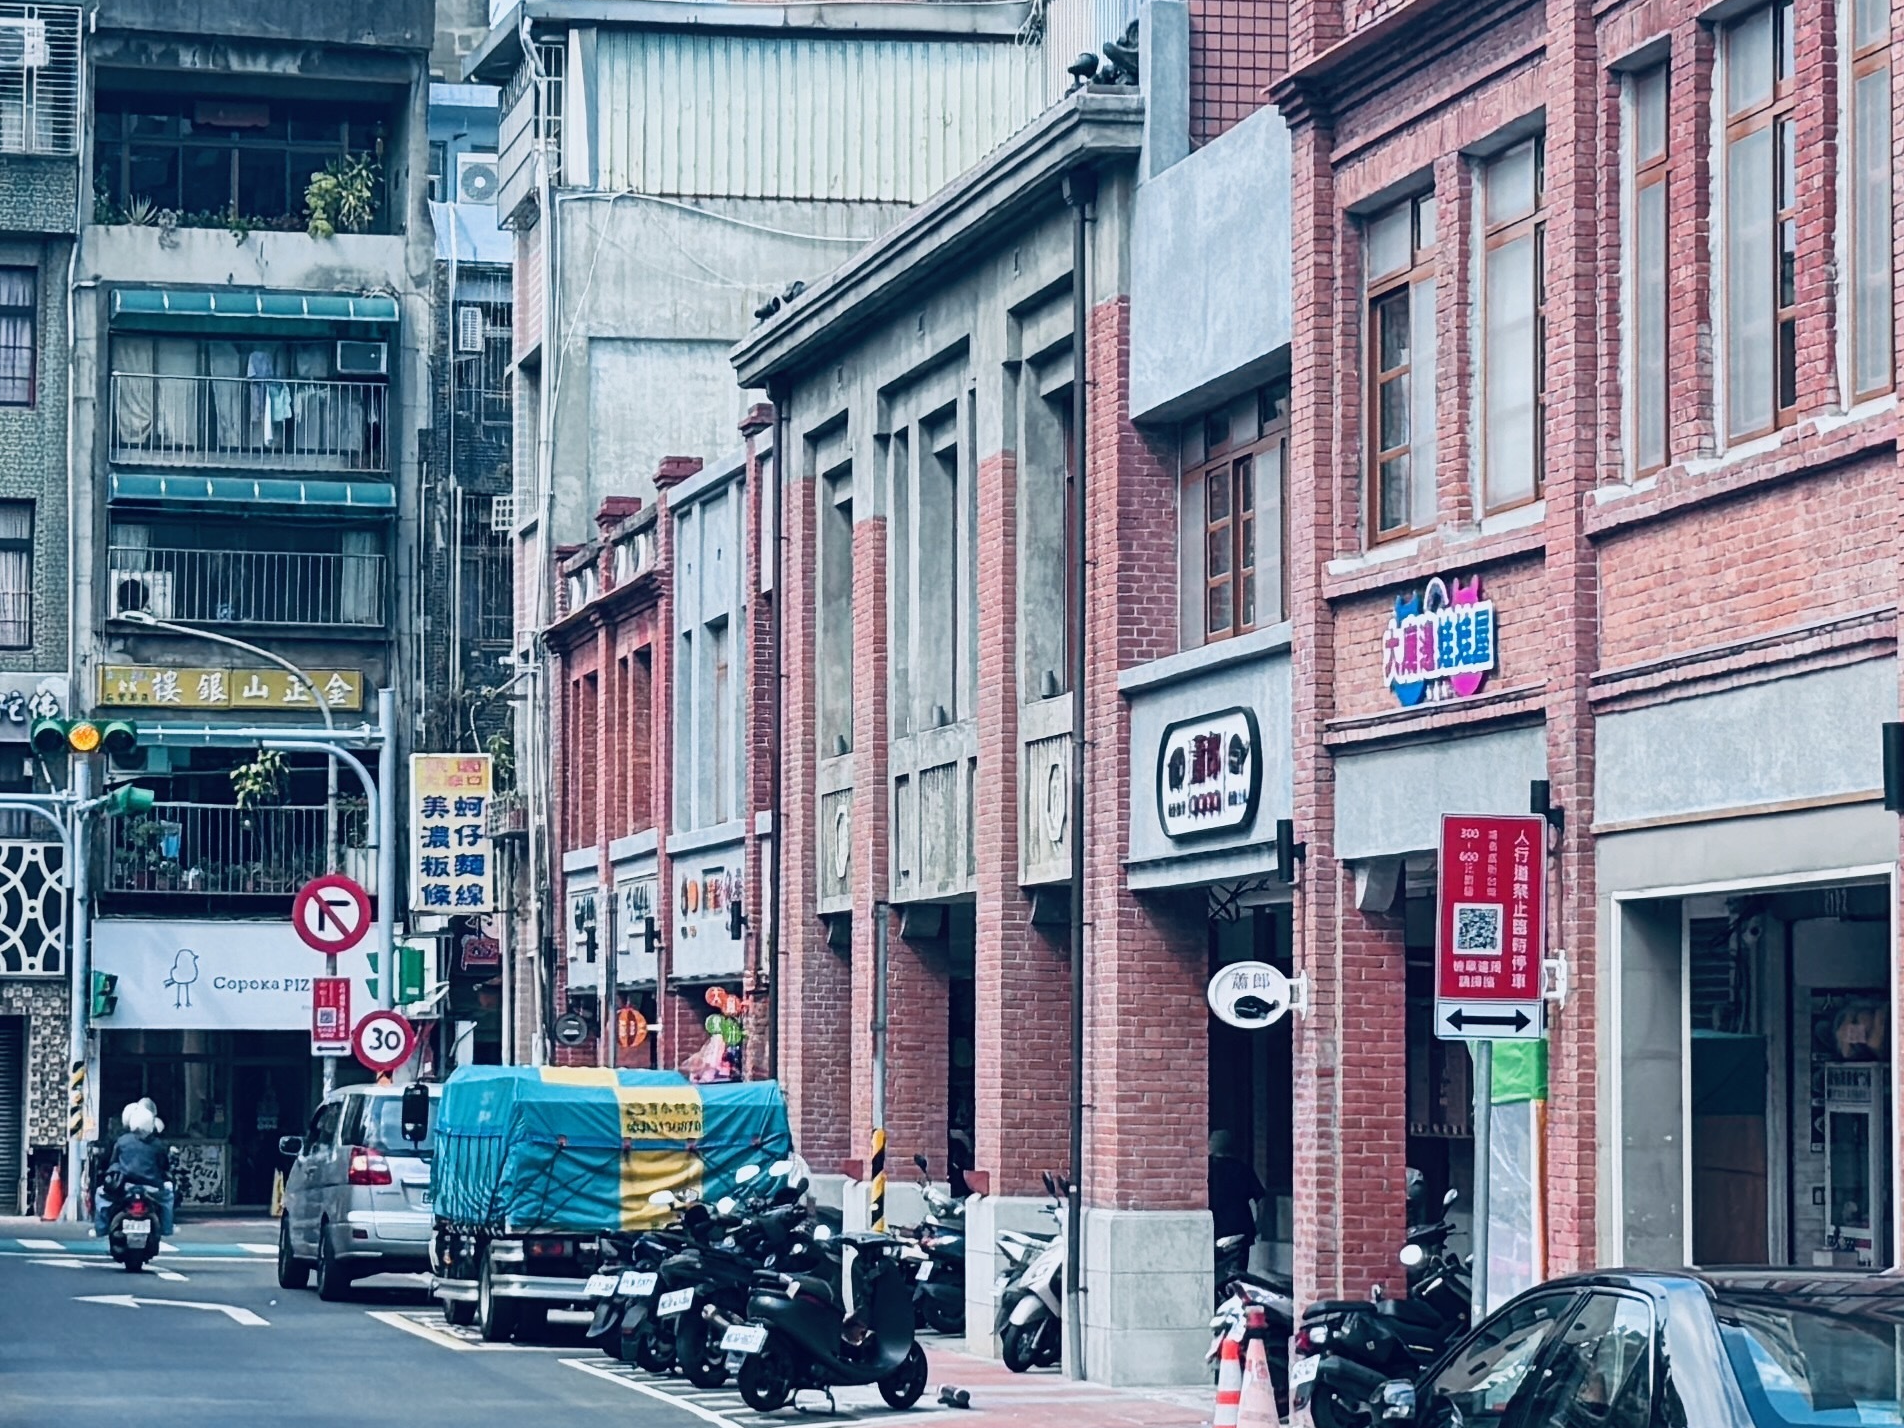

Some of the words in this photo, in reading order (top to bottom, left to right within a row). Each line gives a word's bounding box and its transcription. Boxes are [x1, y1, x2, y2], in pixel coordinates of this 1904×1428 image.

[454, 795, 485, 907] 蚵仔麵線
[1511, 829, 1530, 990] 人行道禁止臨時停車
[368, 1027, 401, 1051] 30
